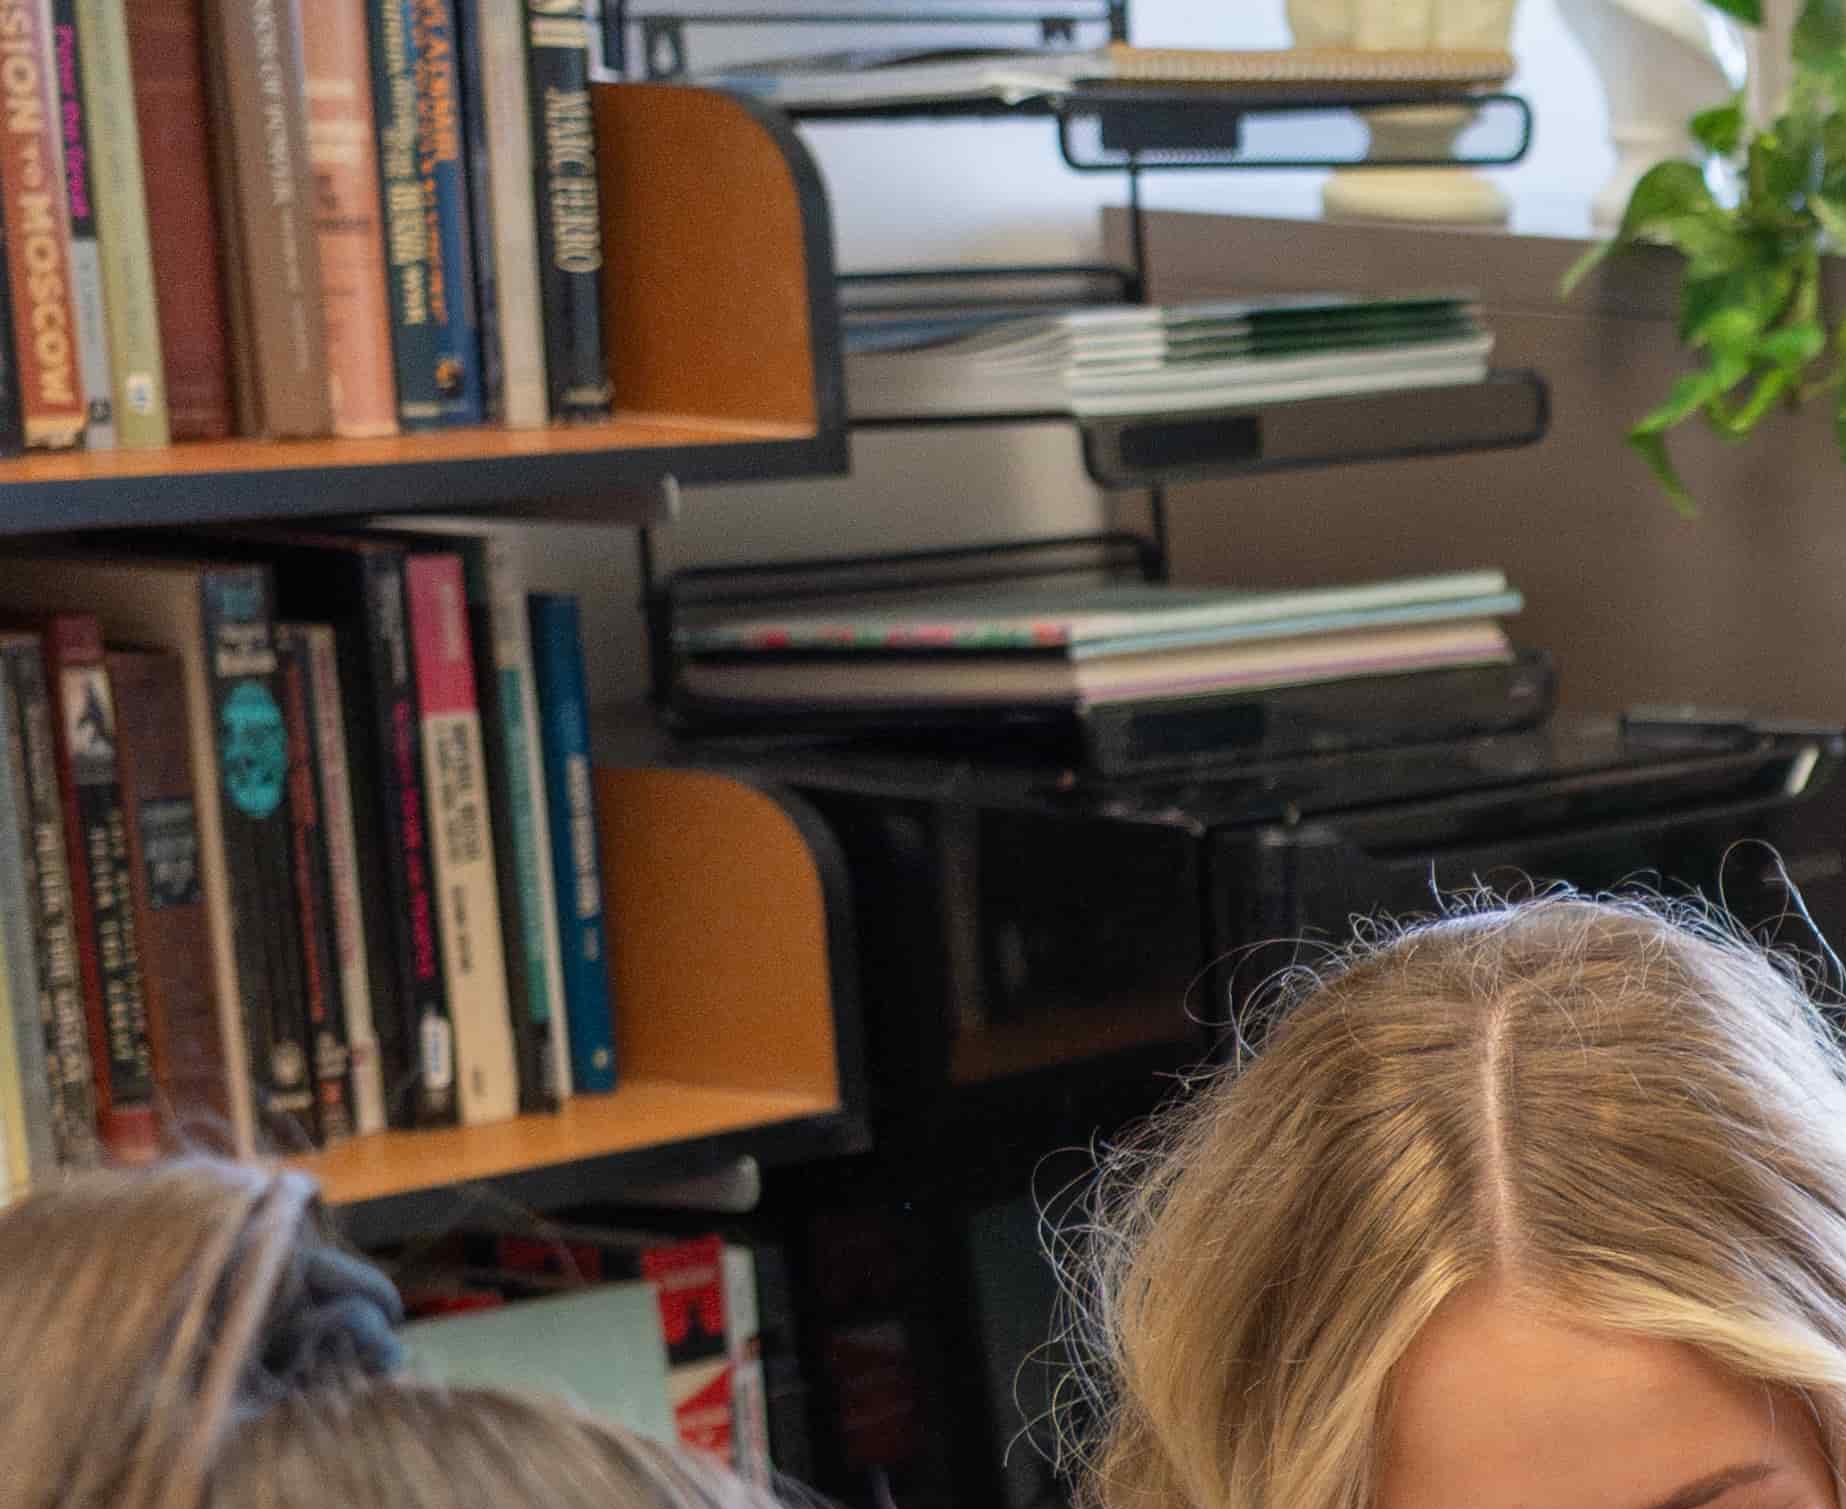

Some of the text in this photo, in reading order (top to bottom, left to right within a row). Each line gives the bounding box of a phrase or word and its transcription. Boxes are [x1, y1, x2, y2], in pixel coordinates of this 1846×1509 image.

[545, 87, 597, 178] MARC
[0, 0, 42, 134] SION
[21, 193, 76, 404] MOSCOW
[69, 144, 91, 219] Great
[549, 178, 603, 273] FERRO
